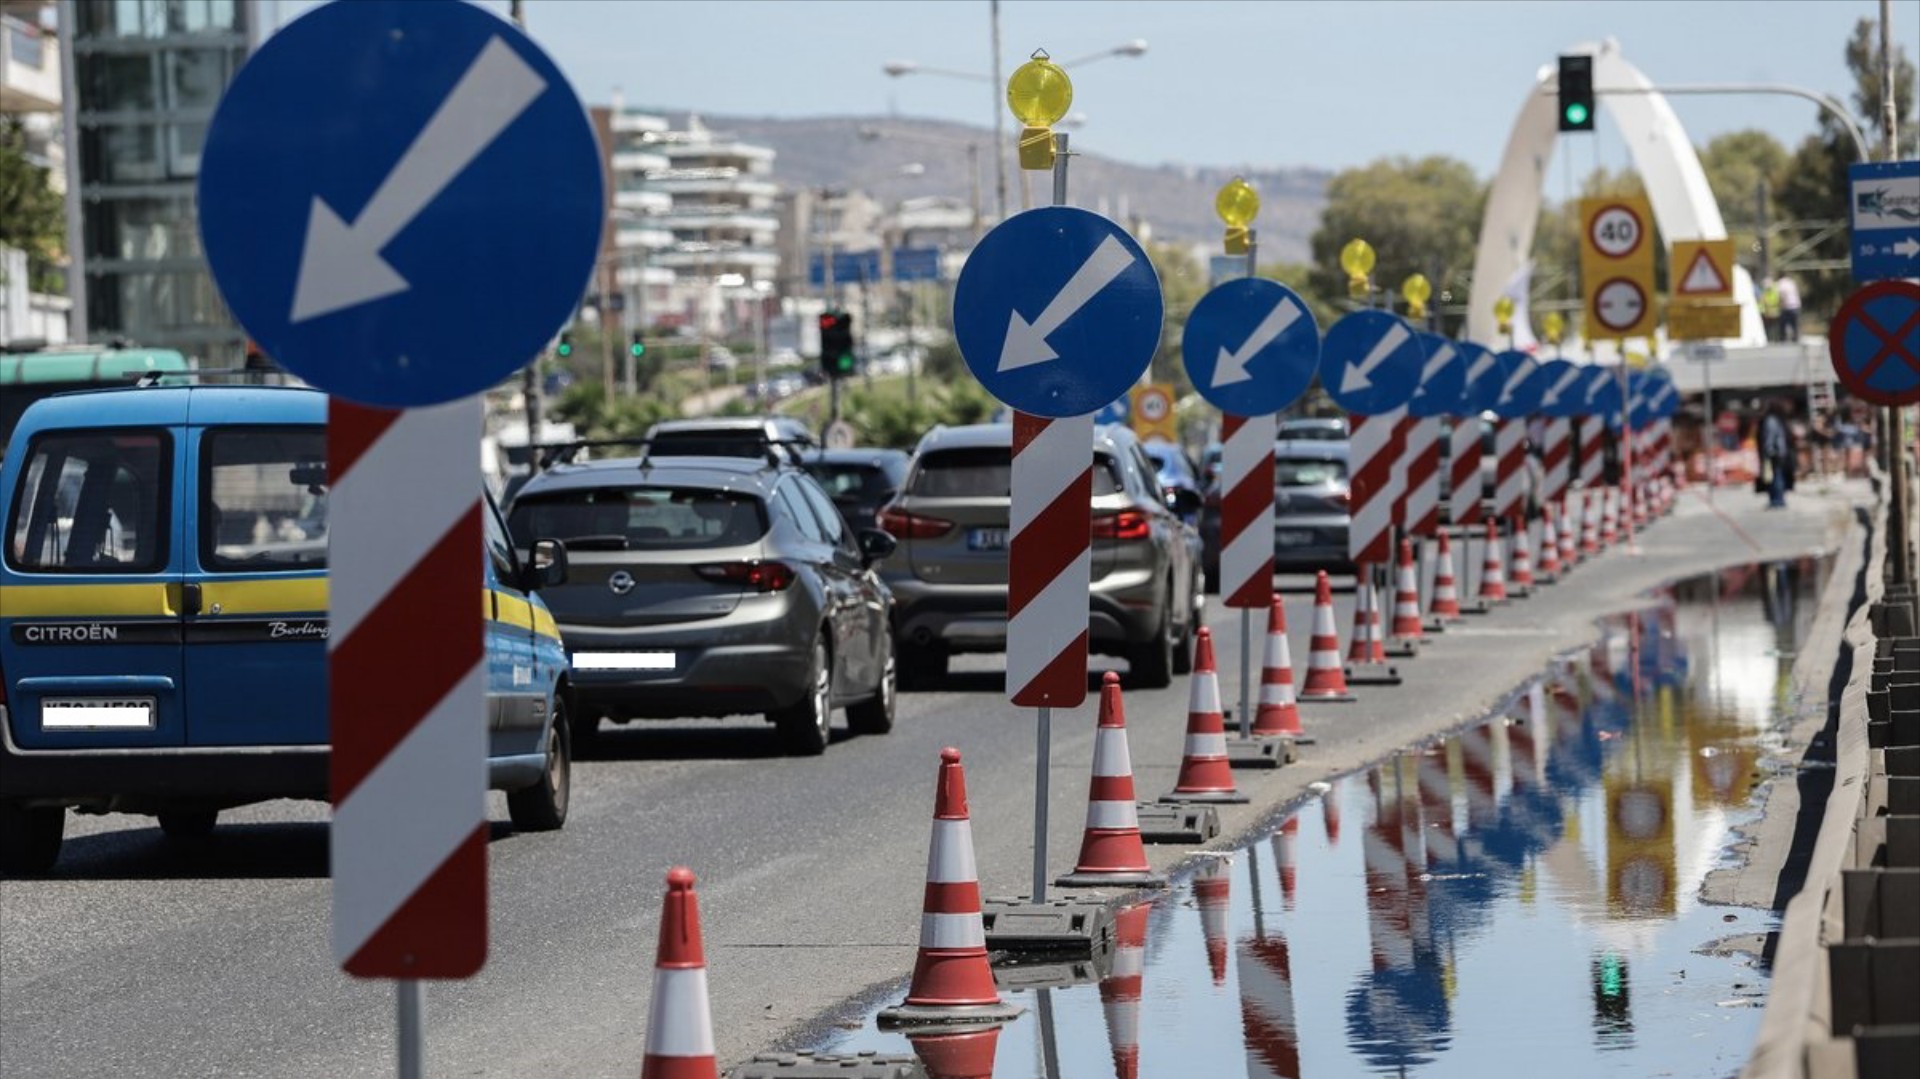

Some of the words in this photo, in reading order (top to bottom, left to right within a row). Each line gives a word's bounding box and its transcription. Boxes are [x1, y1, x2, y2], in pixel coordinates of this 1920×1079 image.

[1601, 219, 1634, 241] 40
[25, 623, 118, 641] CITROËN
[268, 621, 331, 638] Berling
